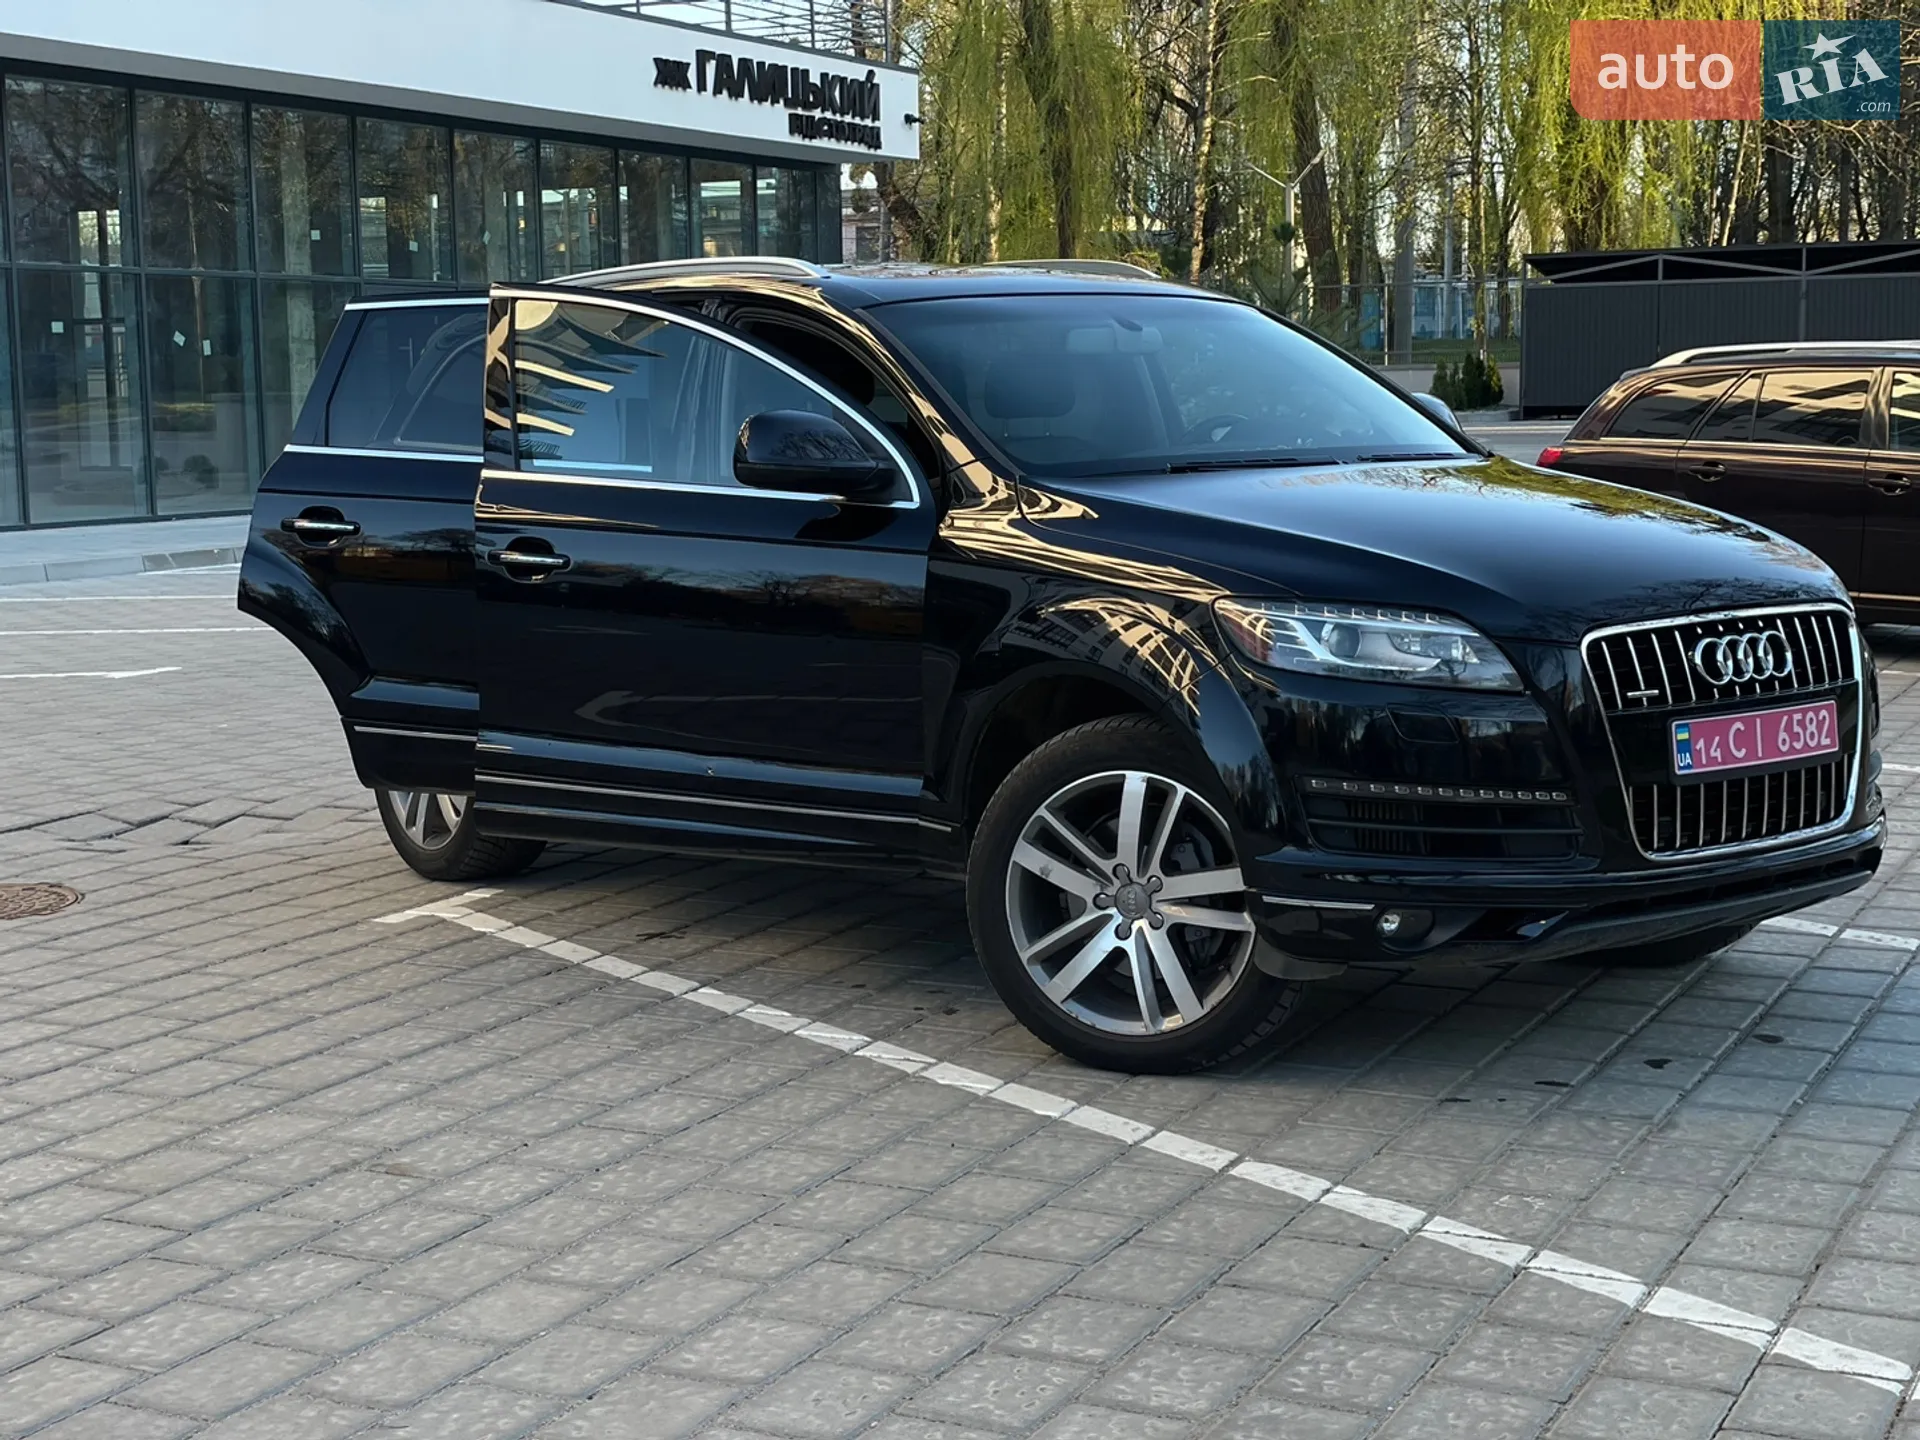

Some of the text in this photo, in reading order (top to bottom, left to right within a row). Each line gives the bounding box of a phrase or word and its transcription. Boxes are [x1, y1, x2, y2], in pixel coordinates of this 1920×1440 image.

[695, 48, 881, 123] ГАЛИЦЬКИЙ
[1778, 709, 1831, 752] 6582
[1677, 752, 1693, 767] UA
